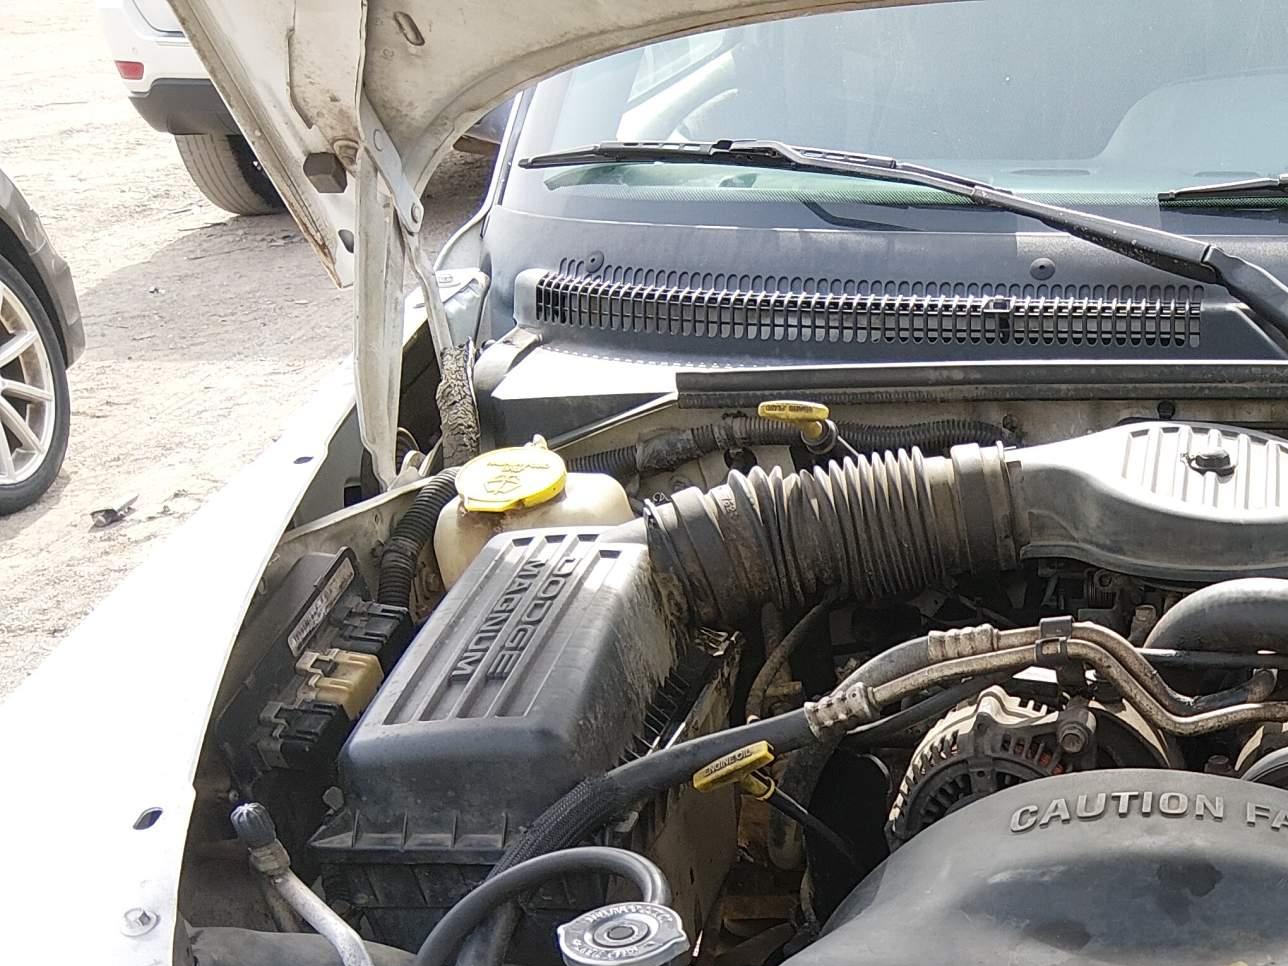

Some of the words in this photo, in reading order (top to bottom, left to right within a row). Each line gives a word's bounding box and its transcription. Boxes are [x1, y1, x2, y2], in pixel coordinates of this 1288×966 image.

[450, 557, 547, 682] MAGNUM
[486, 556, 581, 679] DODGE
[704, 754, 735, 777] ENGINE
[736, 748, 753, 761] OIL
[1010, 790, 1225, 833] CAUTION
